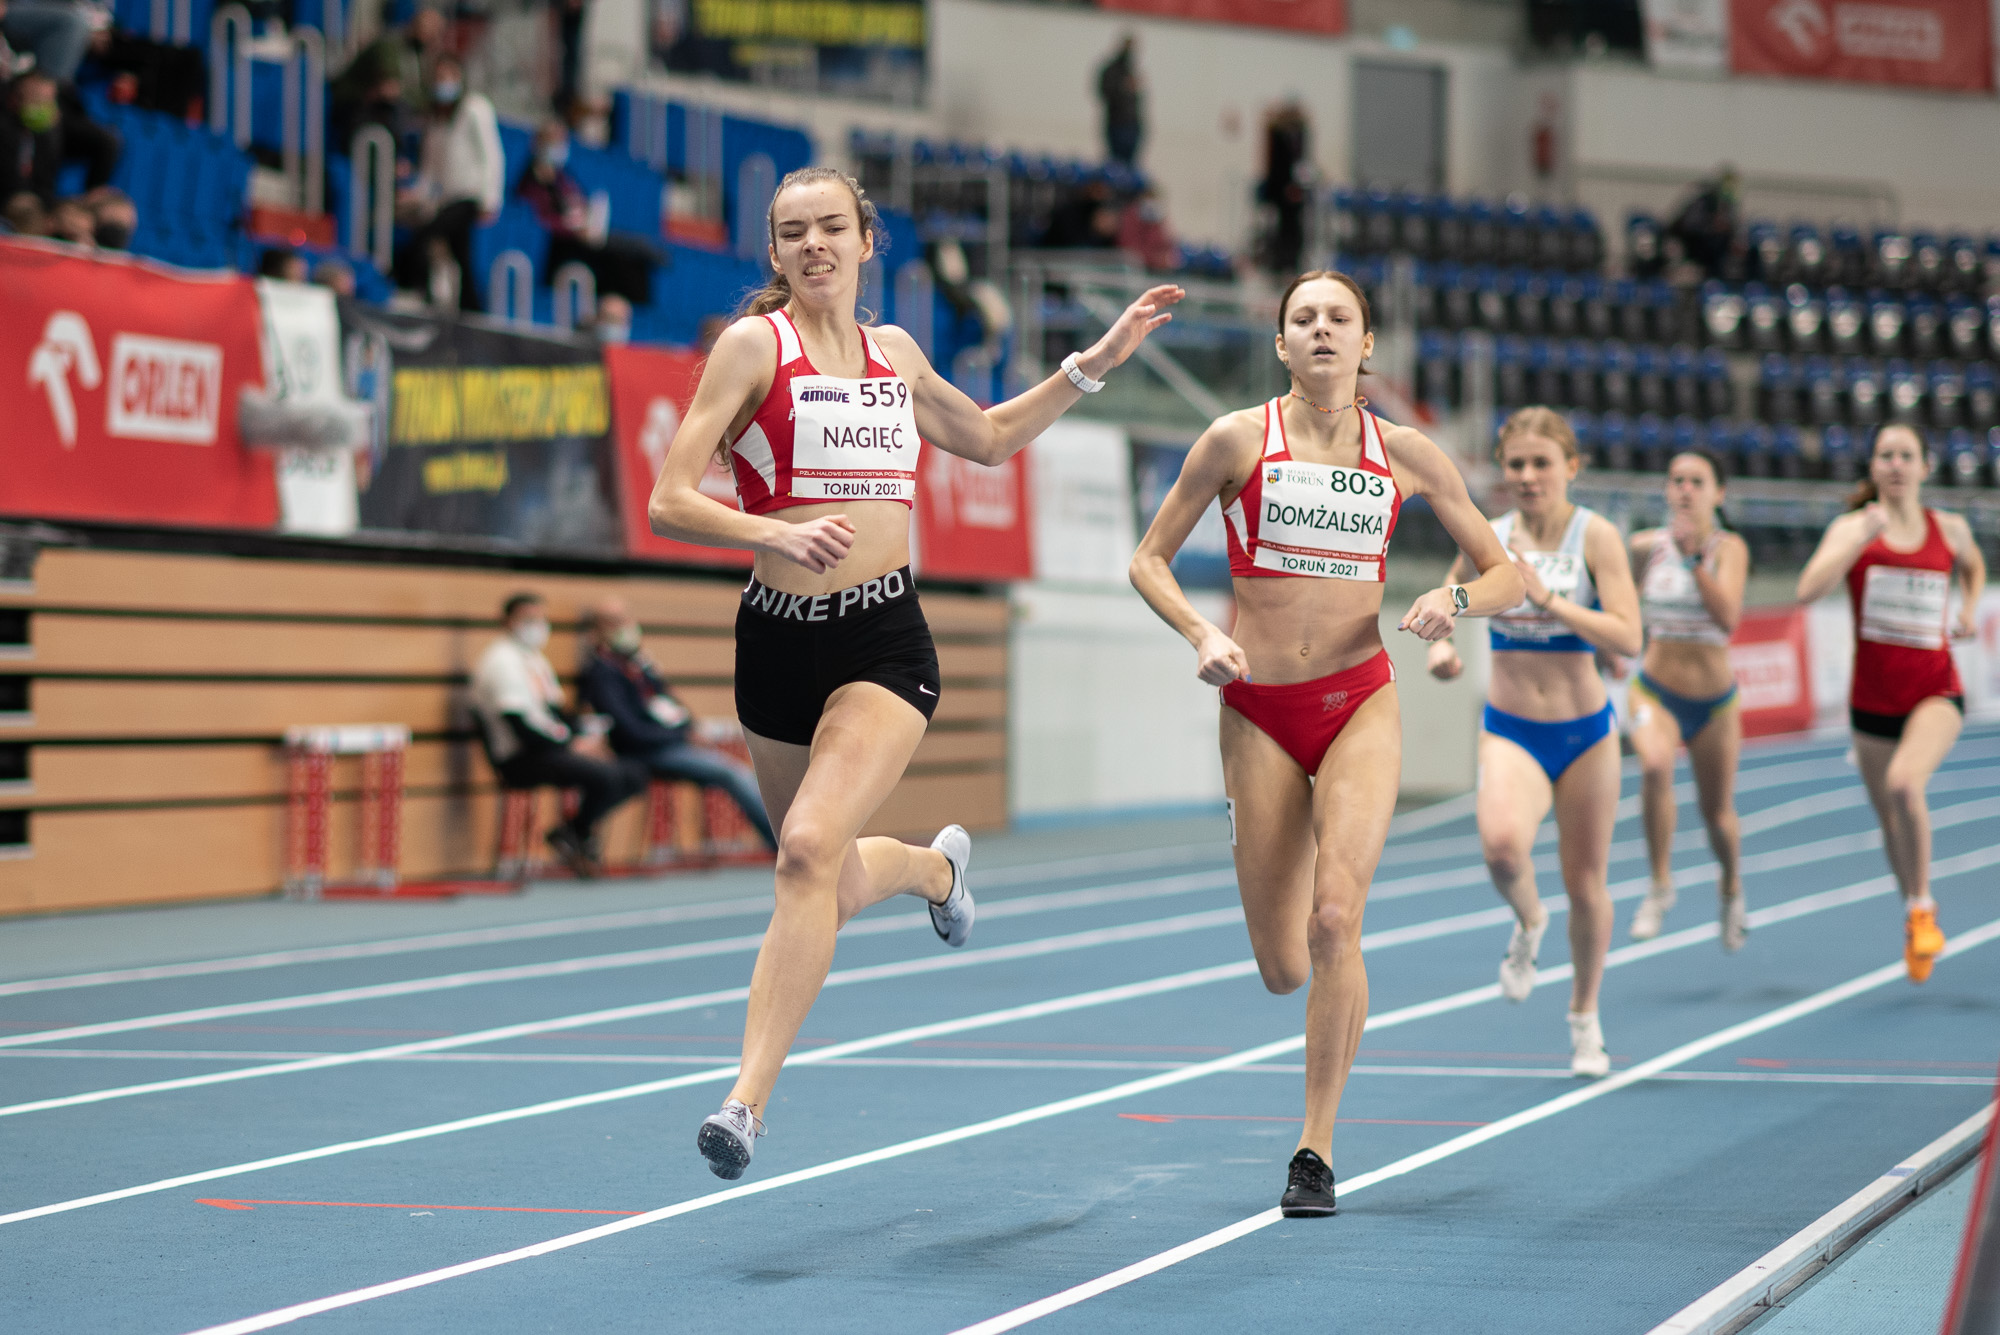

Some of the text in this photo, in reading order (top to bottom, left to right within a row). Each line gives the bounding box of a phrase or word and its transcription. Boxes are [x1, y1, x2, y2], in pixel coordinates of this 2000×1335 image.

[800, 390, 850, 403] 4MOVE
[860, 382, 907, 408] 559
[823, 423, 903, 453] NAGIĘĆ
[823, 480, 903, 496] TORUŃ 2021
[1286, 473, 1324, 487] TORUŃ
[1331, 470, 1384, 497] 803
[1267, 504, 1383, 535] DOMŻALSKA
[1281, 556, 1359, 577] TORUŃ 2021
[751, 570, 905, 622] NIKE PRO
